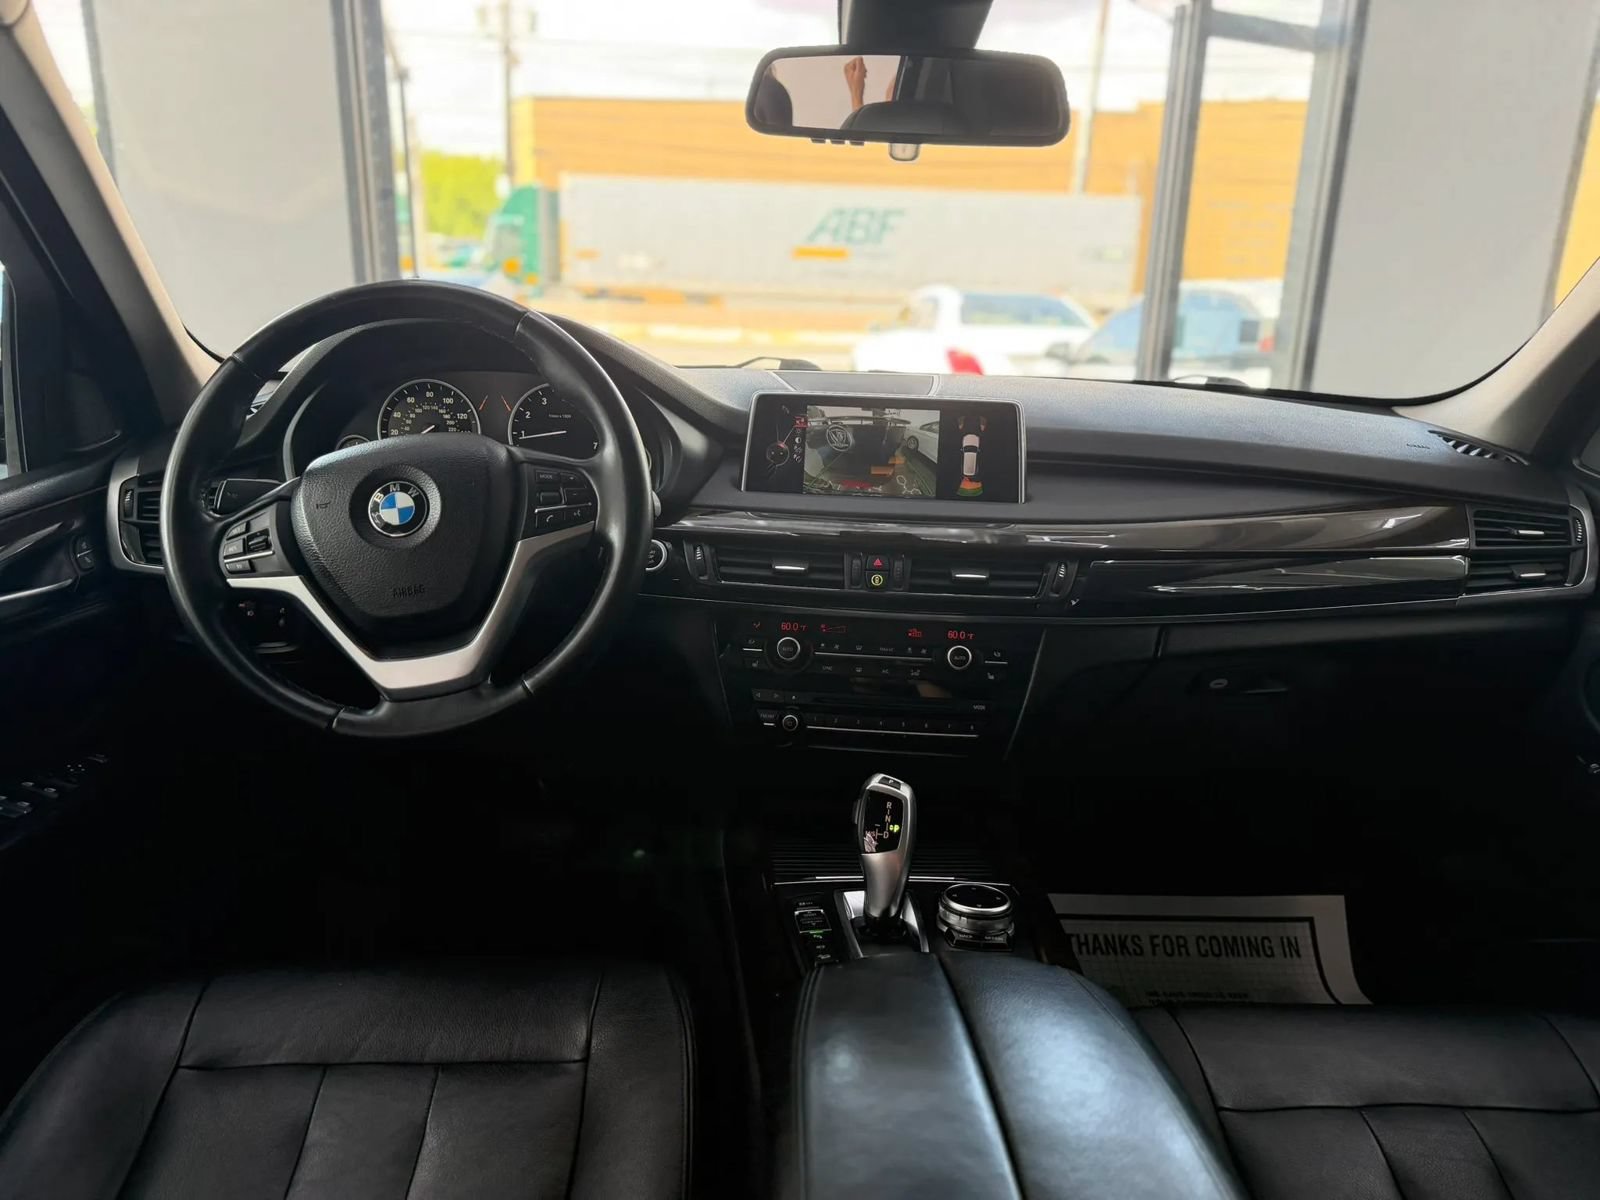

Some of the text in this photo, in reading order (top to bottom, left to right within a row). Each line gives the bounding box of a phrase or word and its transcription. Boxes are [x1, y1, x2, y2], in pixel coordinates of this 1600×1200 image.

[806, 207, 905, 245] ABF
[541, 397, 547, 405] 3
[593, 442, 599, 450] 7
[374, 484, 420, 503] BMW
[393, 584, 425, 598] AIRBAG
[886, 801, 893, 809] R
[885, 815, 892, 824] N
[883, 831, 890, 840] D
[1150, 935, 1190, 958] FOR
[1195, 935, 1275, 959] COMING
[1279, 936, 1303, 959] IN
